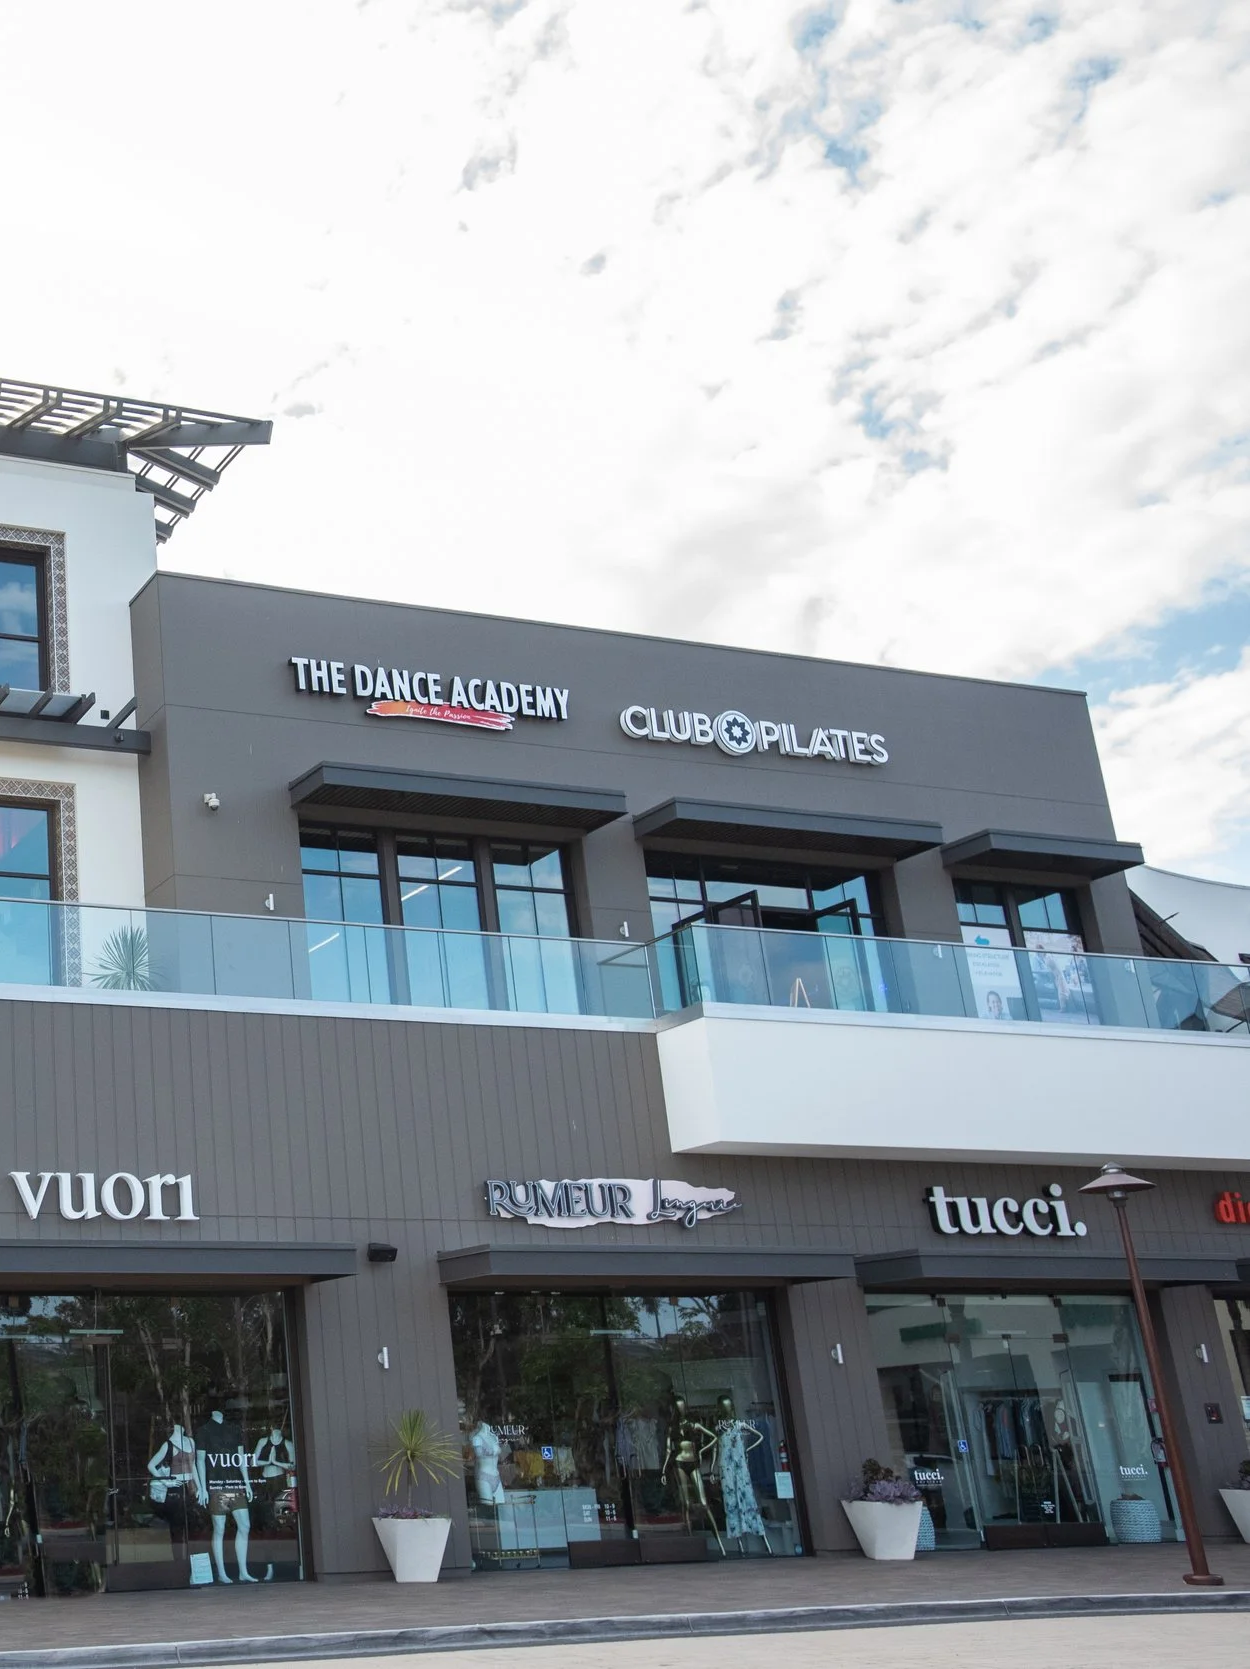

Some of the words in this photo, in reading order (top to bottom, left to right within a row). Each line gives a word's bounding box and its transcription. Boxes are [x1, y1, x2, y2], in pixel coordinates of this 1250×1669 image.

[290, 656, 347, 695] THE
[352, 664, 444, 705] DANCE
[450, 676, 569, 721] ACADEMY
[406, 705, 427, 714] Ignite
[430, 706, 441, 716] the
[444, 710, 471, 720] Passion
[619, 705, 715, 746] CLUB
[756, 720, 889, 766] PILATES
[8, 1171, 200, 1221] vuori
[485, 1180, 635, 1218] RUMEUR
[647, 1178, 742, 1229] Lingerie
[926, 1183, 1087, 1237] tucci.
[1214, 1191, 1250, 1224] di
[207, 1452, 258, 1468] vuori
[914, 1468, 945, 1481] tucci.
[1119, 1463, 1148, 1476] tucci.
